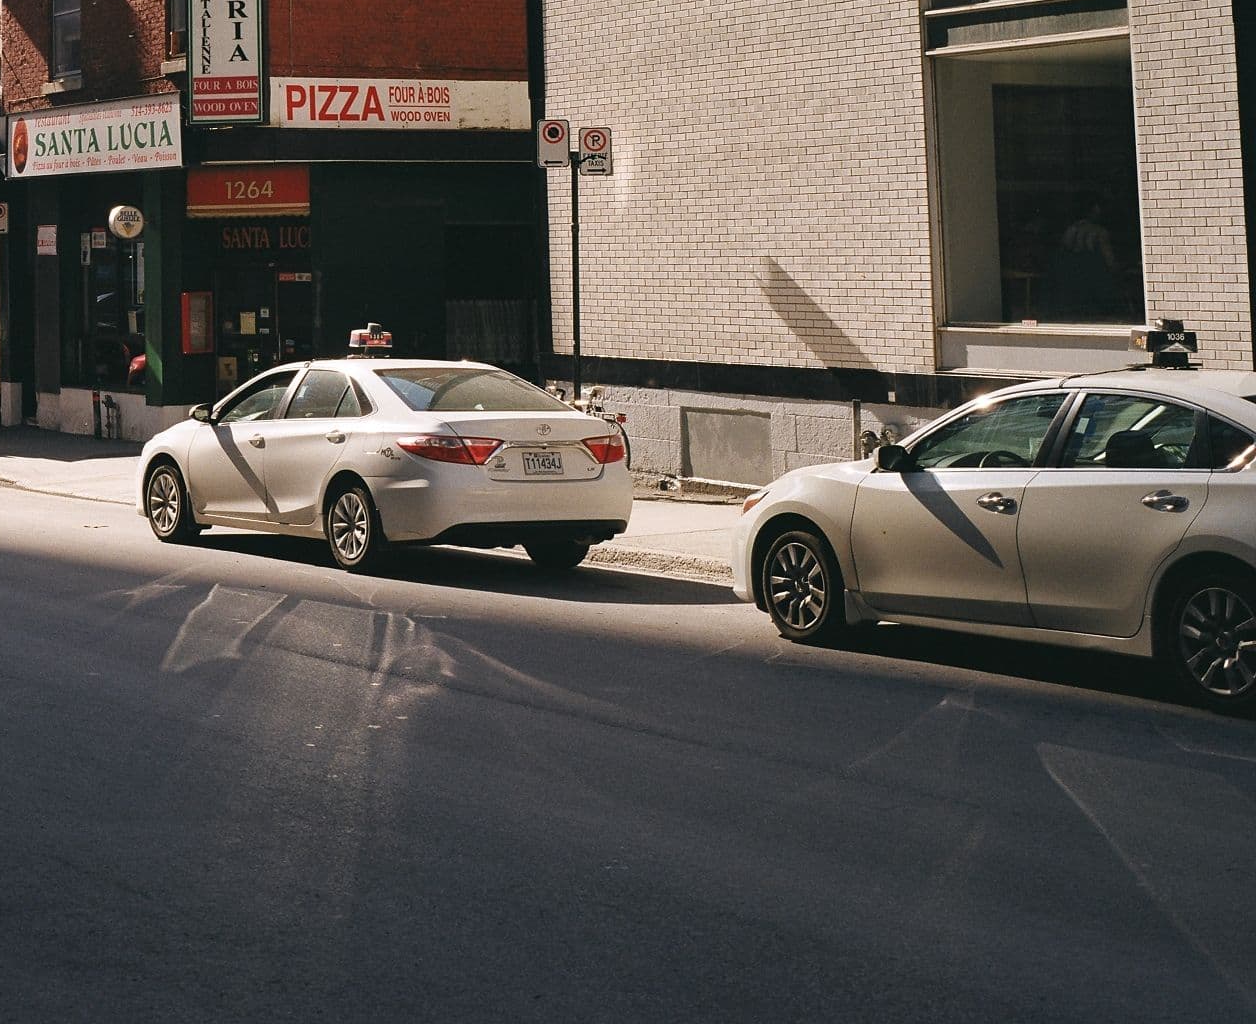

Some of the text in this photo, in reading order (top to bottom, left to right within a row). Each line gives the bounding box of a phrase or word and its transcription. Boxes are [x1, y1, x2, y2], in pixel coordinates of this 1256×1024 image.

[194, 81, 220, 91] FOUR
[236, 78, 258, 90] BOIS
[285, 84, 385, 121] PIZZA
[389, 86, 415, 103] FOUR
[427, 86, 450, 103] BOIS
[194, 101, 258, 113] WOOD OVEN
[390, 110, 450, 121] WOOD OVEN
[35, 120, 173, 157] SANTA LUCIA
[224, 180, 274, 199] 1264
[222, 227, 270, 248] SANTA
[525, 457, 562, 470] T11434J
